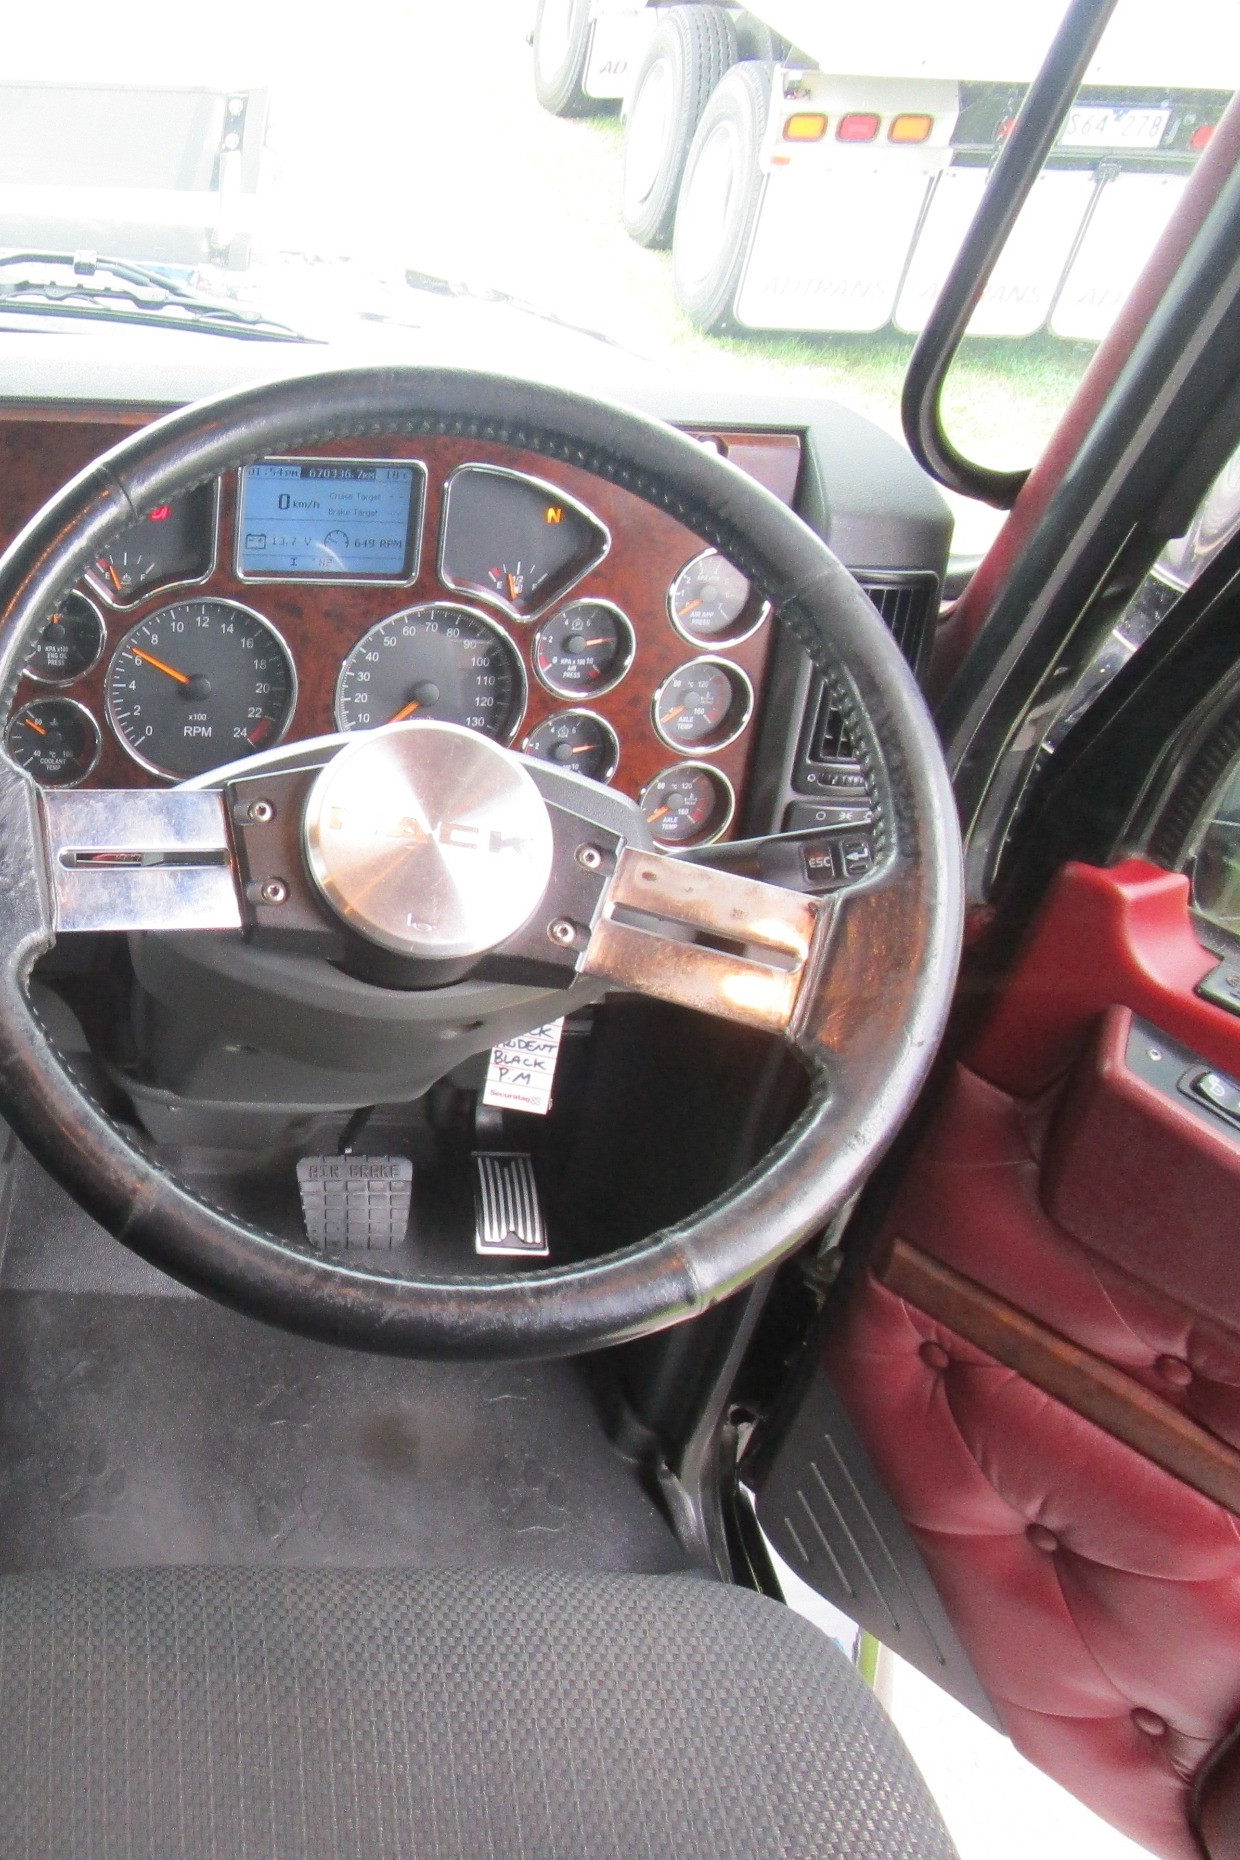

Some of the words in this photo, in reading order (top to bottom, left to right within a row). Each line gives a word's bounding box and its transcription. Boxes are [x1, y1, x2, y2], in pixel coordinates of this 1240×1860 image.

[1067, 113, 1109, 135] S64
[1121, 115, 1162, 137] 278
[760, 277, 886, 299] ADTRANS
[278, 494, 290, 510] 0
[292, 501, 320, 509] km/h
[547, 508, 562, 524] N
[380, 540, 403, 548] RPM
[105, 572, 110, 580] E
[140, 574, 146, 582] F
[496, 580, 502, 590] E
[196, 616, 210, 627] 12
[171, 622, 184, 632] 10
[221, 623, 234, 634] 14
[402, 626, 416, 636] 60
[425, 622, 438, 632] 70
[446, 628, 460, 638] 80
[151, 634, 158, 644] 8
[240, 638, 254, 648] 16
[384, 637, 396, 647] 50
[37, 644, 42, 652] 0
[464, 640, 476, 650] 90
[134, 655, 142, 666] 6
[366, 652, 379, 662] 40
[471, 657, 490, 666] 100
[254, 659, 266, 670] 18
[357, 672, 370, 682] 30
[476, 676, 496, 686] 110
[128, 680, 136, 690] 4
[256, 683, 270, 694] 20
[354, 692, 368, 703] 20
[474, 696, 494, 706] 120
[134, 705, 140, 716] 2
[248, 708, 262, 718] 22
[358, 714, 370, 722] 10
[466, 716, 484, 726] 130
[146, 726, 152, 736] 0
[184, 726, 212, 736] RPM
[233, 727, 248, 738] 24
[808, 856, 831, 868] ESC
[494, 1050, 546, 1070] BLACK
[490, 1090, 531, 1103] Securatag
[310, 1164, 340, 1178] AIR
[350, 1164, 402, 1178] BRAKE
